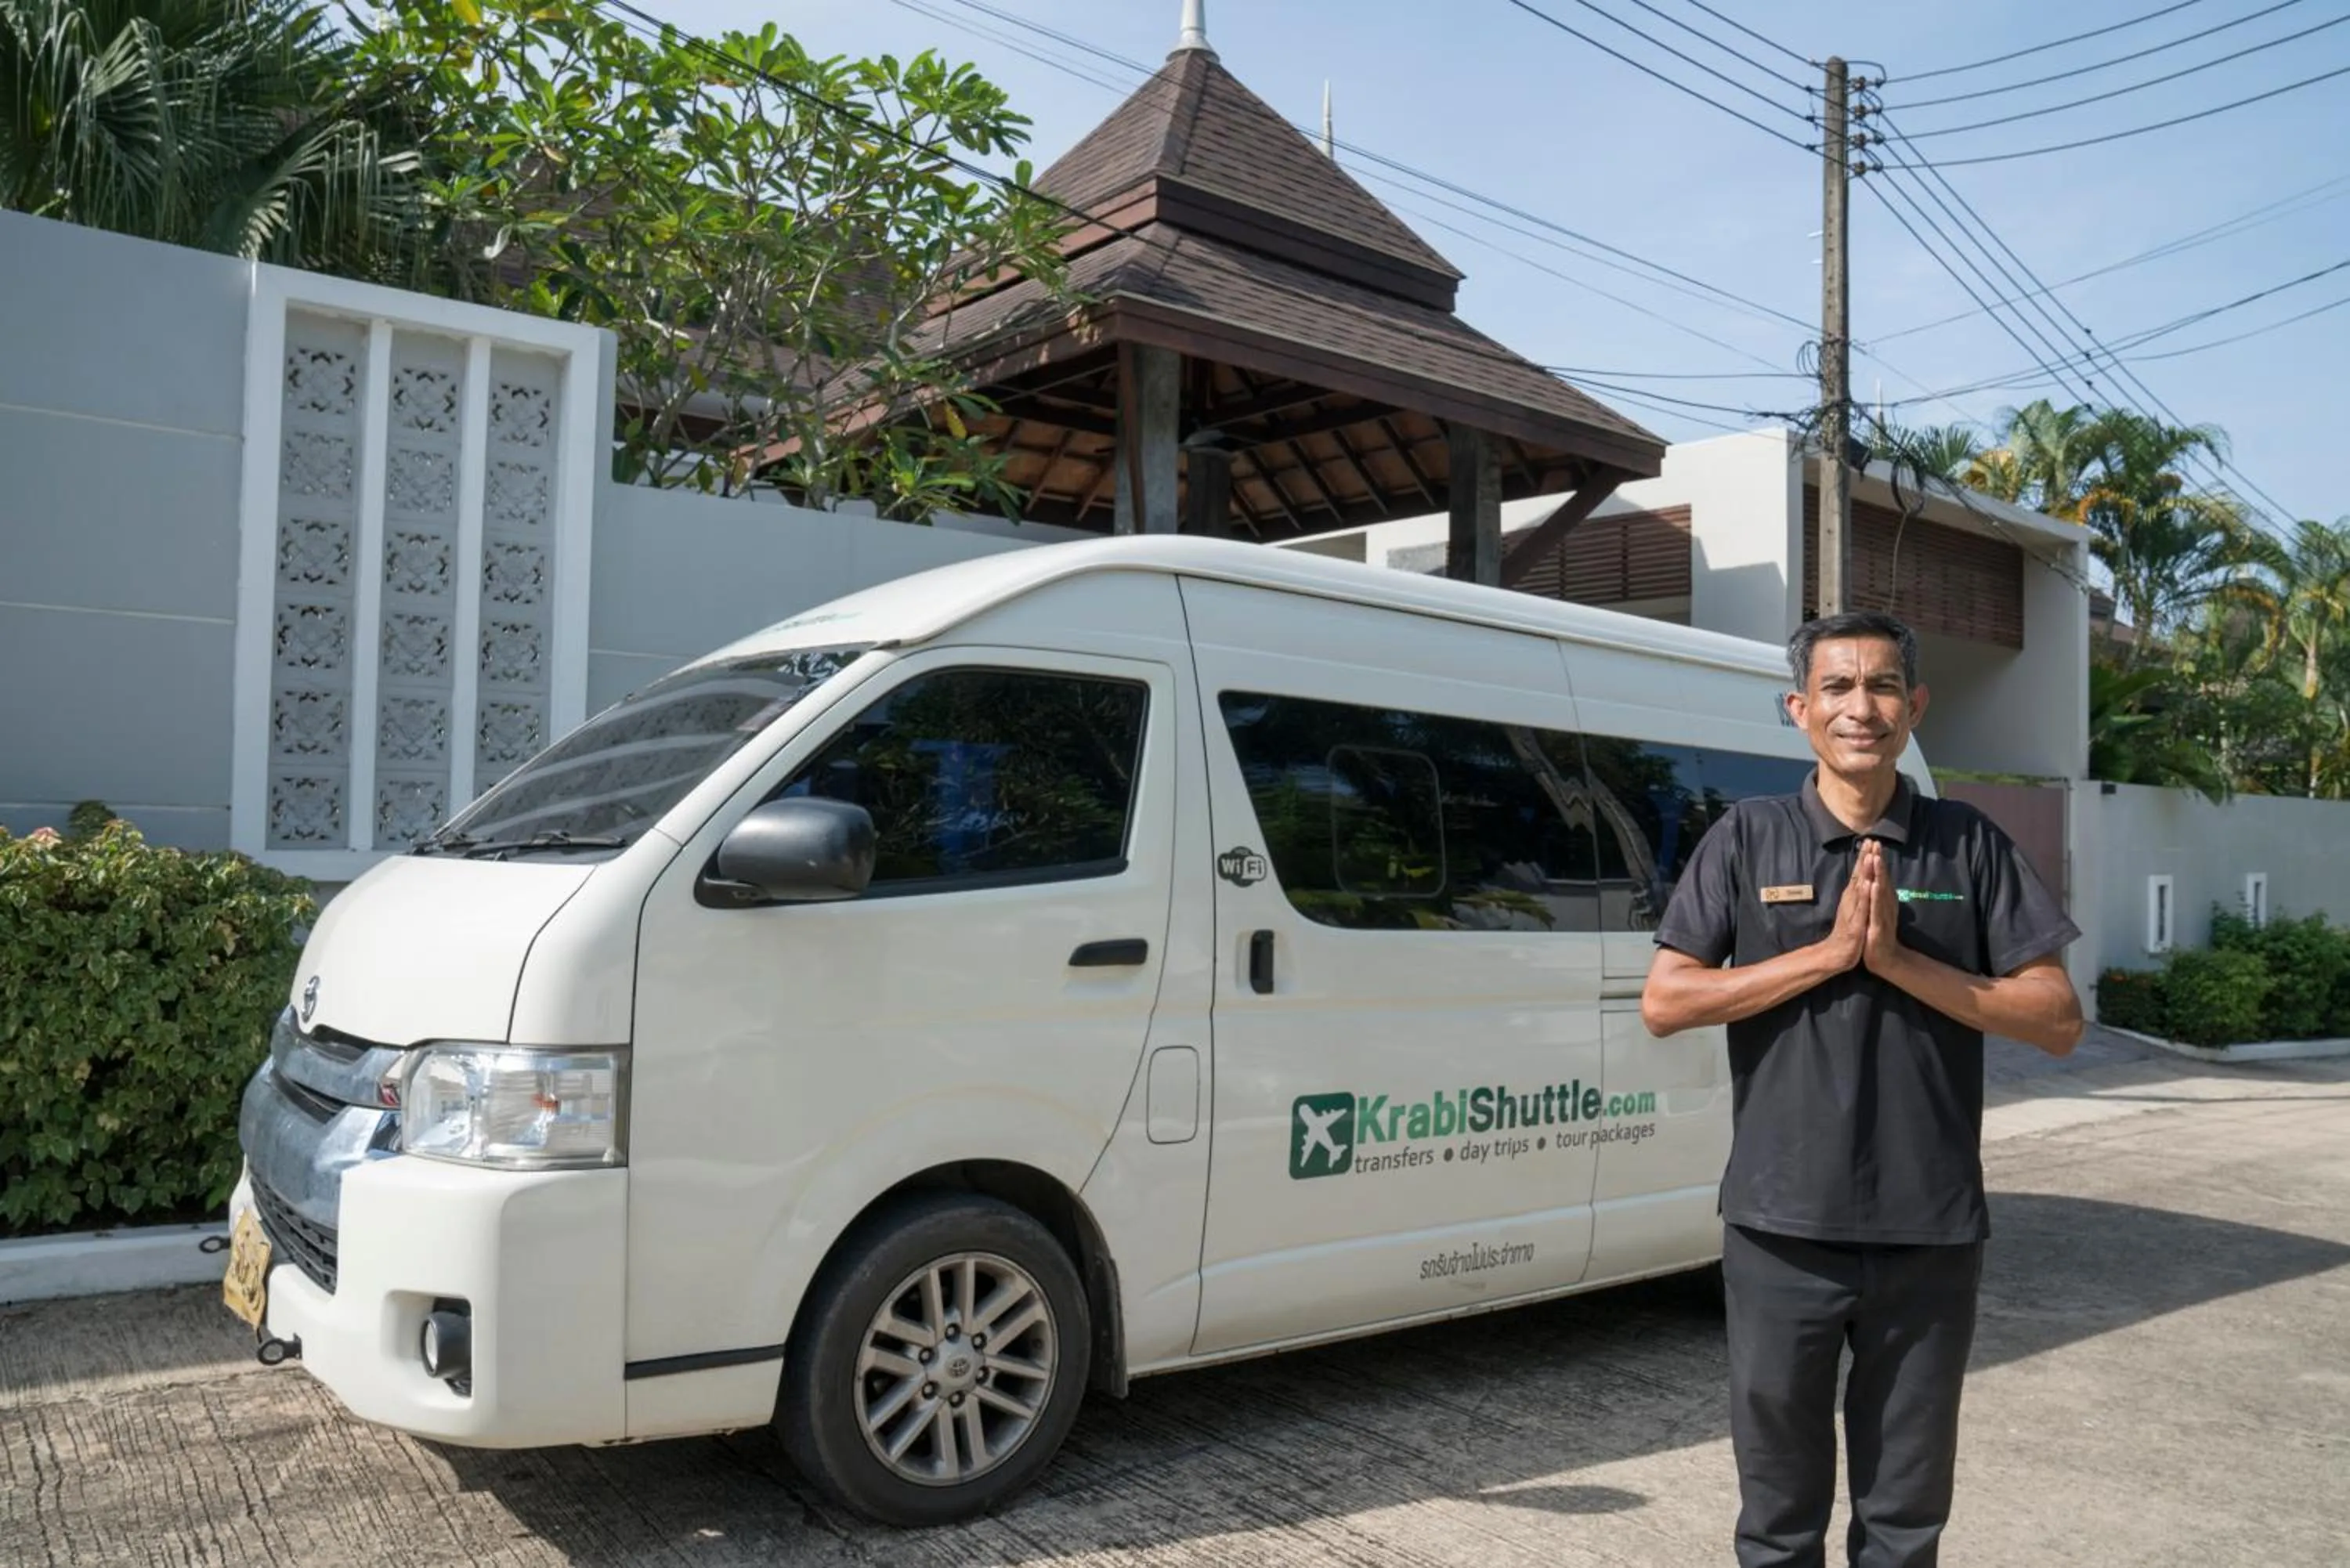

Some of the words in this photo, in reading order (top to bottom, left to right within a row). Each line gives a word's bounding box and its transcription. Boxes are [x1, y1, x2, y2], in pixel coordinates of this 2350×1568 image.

[1355, 1147, 1434, 1173] transfers
[1459, 1140, 1490, 1165] day
[1494, 1138, 1529, 1160] trips
[1555, 1130, 1588, 1149] tour
[1590, 1122, 1656, 1151] packages
